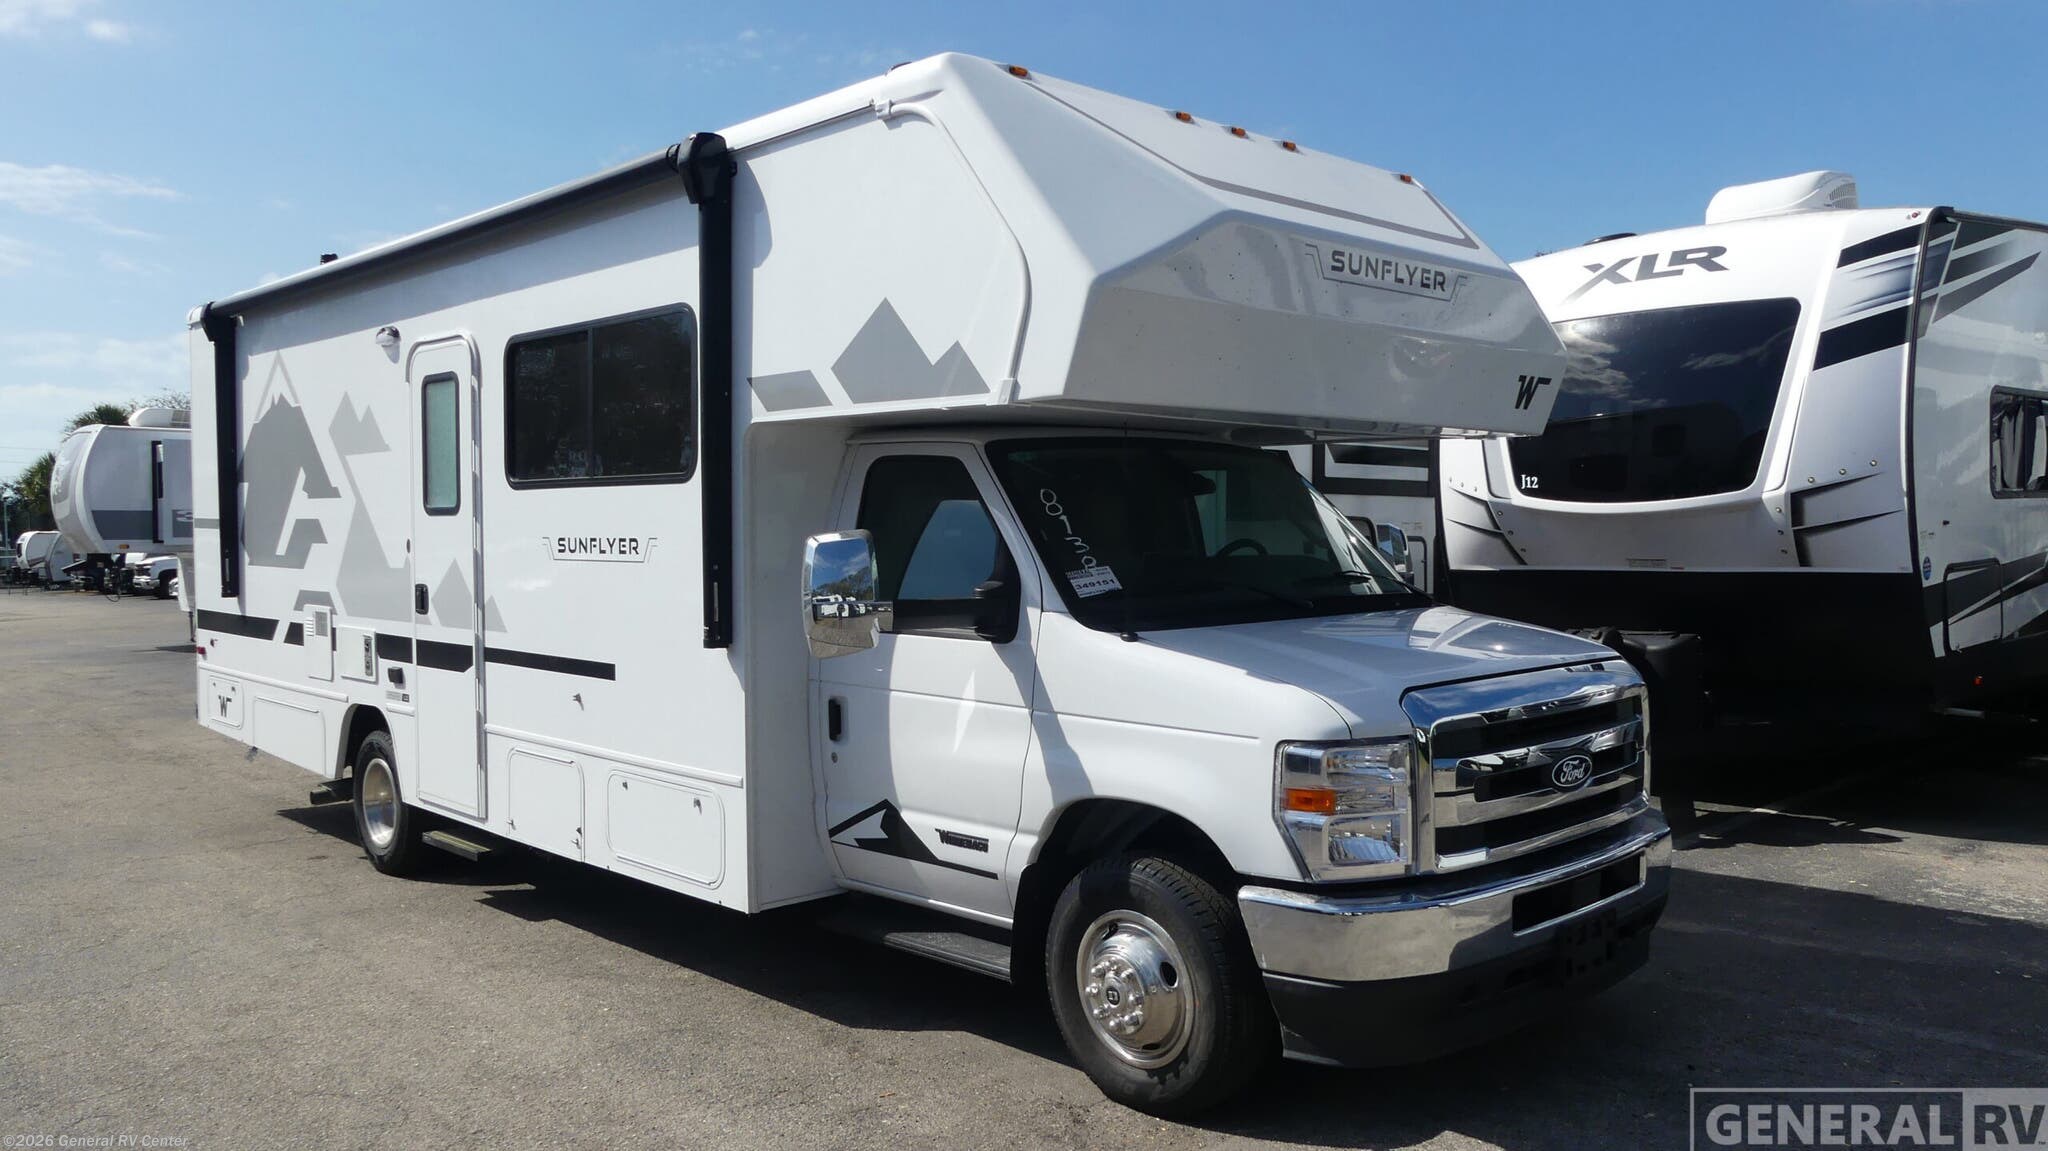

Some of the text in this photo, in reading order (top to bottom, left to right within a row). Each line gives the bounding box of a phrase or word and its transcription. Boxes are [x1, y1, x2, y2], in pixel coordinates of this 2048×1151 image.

[1330, 249, 1447, 293] SUNFLYER
[1567, 245, 1730, 301] XLR
[1520, 474, 1539, 490] J12
[557, 537, 640, 555] SUNFLYER
[1560, 759, 1586, 783] Ford
